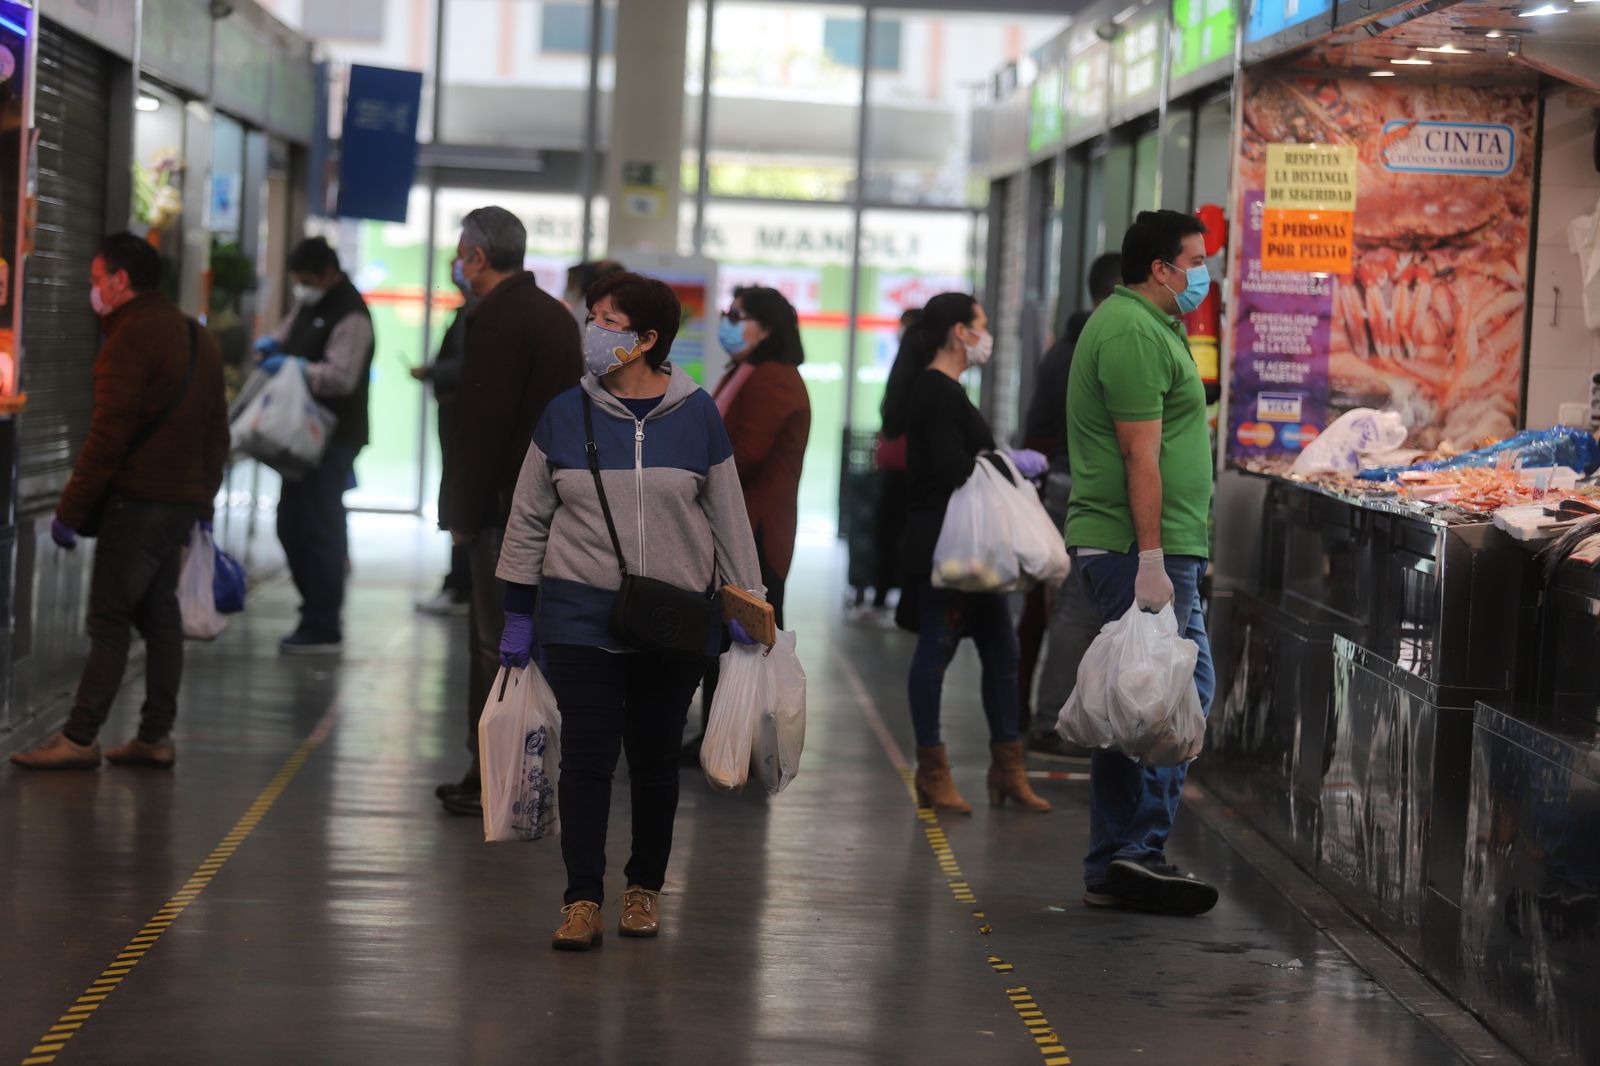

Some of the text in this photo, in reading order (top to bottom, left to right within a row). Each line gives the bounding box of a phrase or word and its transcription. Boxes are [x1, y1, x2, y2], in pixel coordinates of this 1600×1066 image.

[1425, 130, 1504, 154] CINTA
[1285, 152, 1339, 165] RESPETEN
[1275, 170, 1348, 184] LA DISTANCIA
[1270, 188, 1352, 202] DE SEGURIDAD
[1270, 223, 1278, 236] 3
[1283, 223, 1346, 238] PERSONAS
[757, 226, 921, 256] MANOLI
[1267, 243, 1347, 258] POR PUESTO
